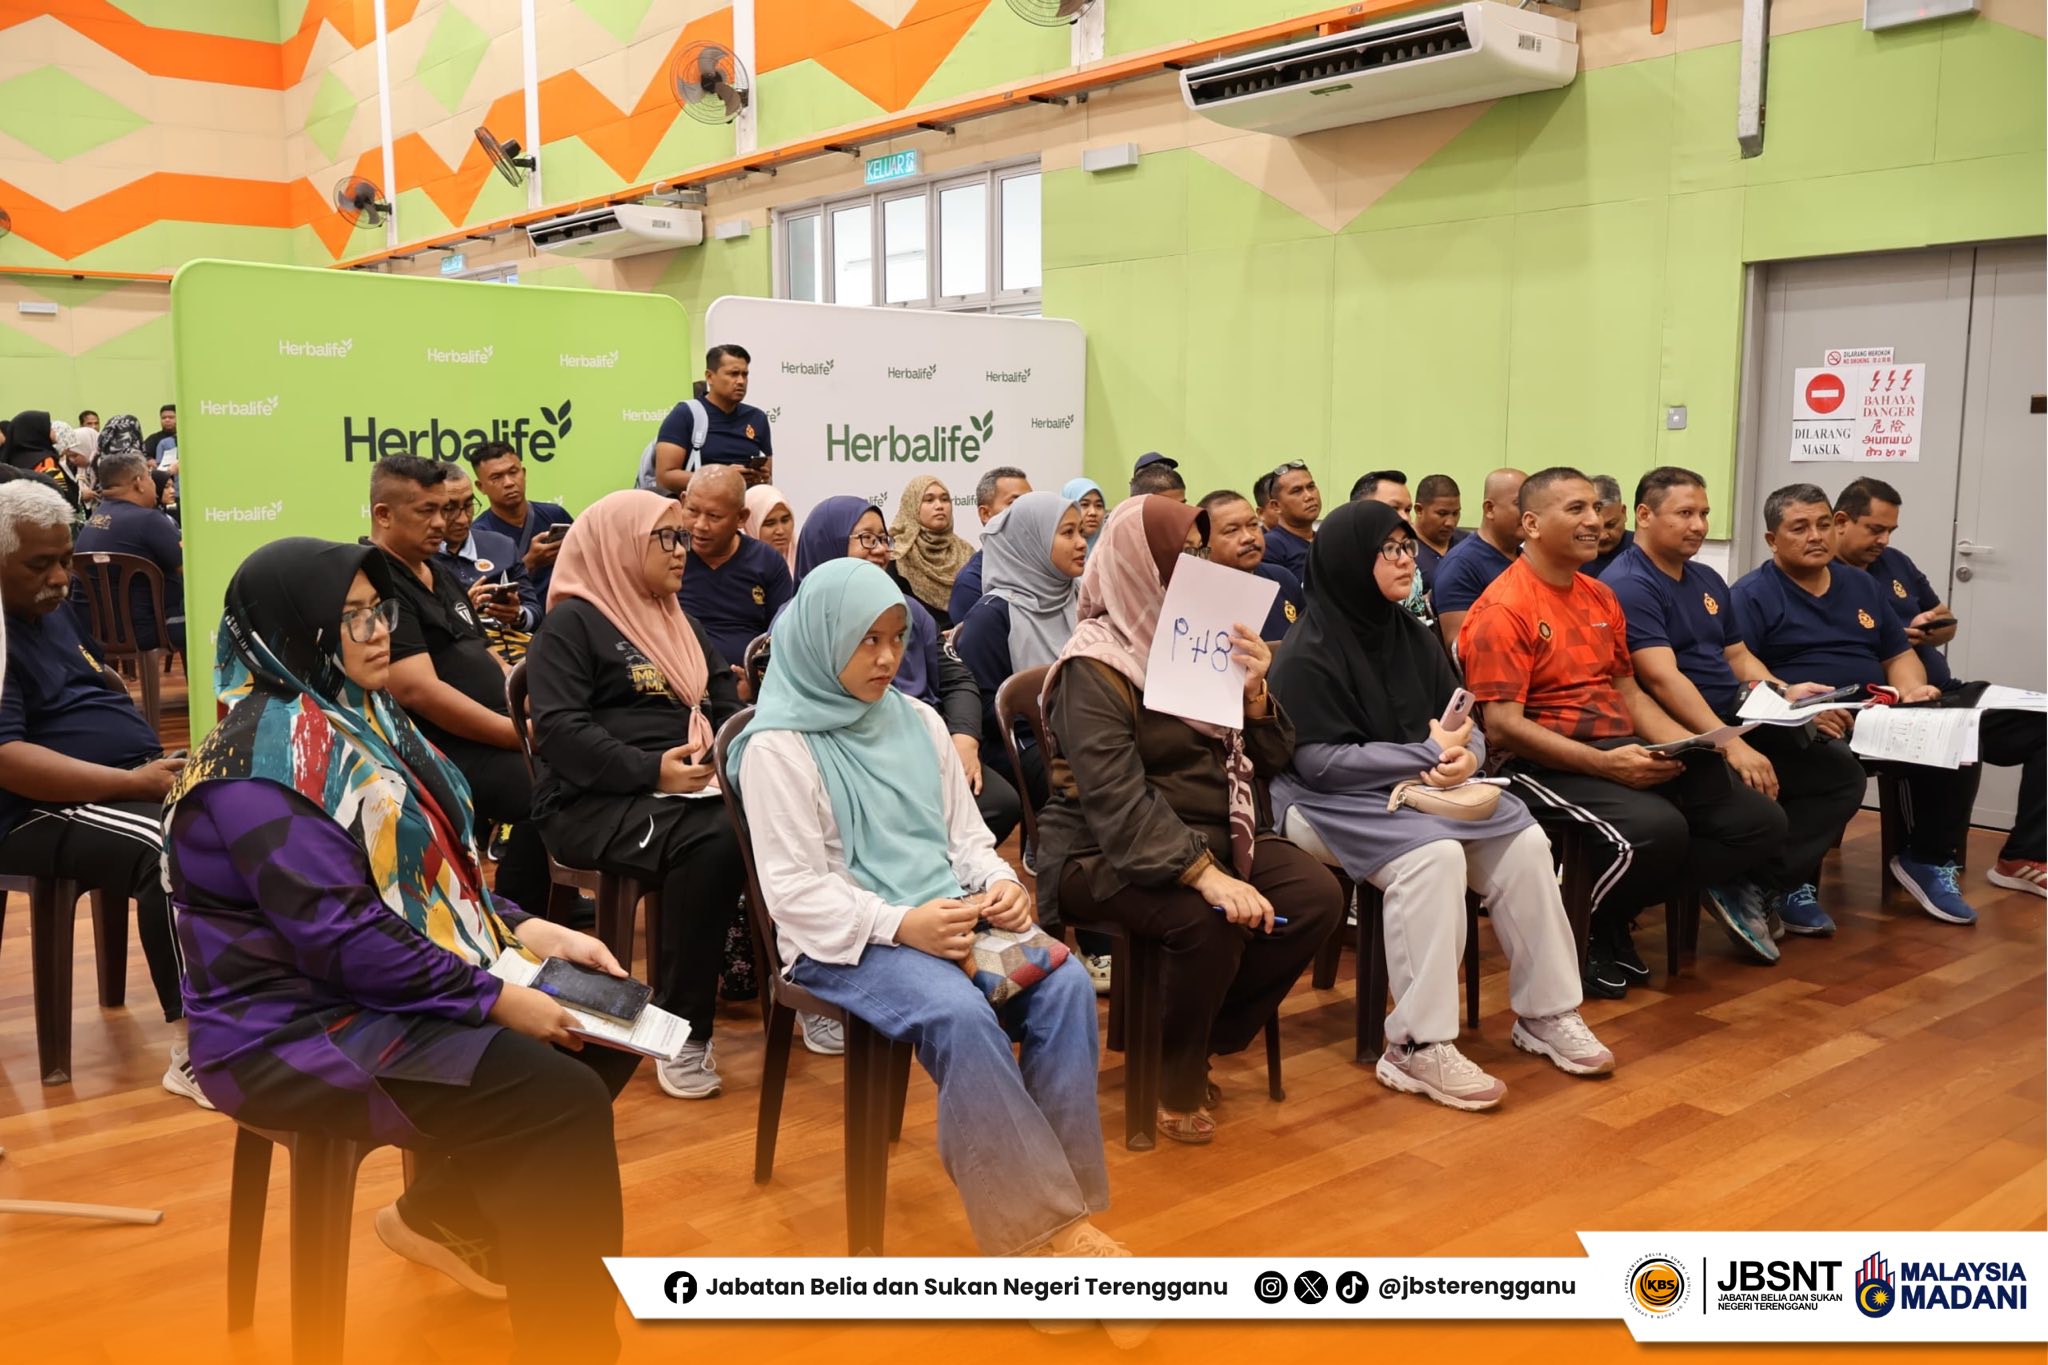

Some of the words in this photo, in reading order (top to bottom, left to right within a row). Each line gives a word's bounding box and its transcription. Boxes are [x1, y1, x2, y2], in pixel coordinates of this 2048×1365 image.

[867, 153, 904, 181] KELUAR
[278, 340, 347, 357] Herbalife
[427, 348, 487, 364] Herbalife
[559, 353, 613, 368] Herbalife
[781, 362, 830, 376] Herbalife
[887, 367, 932, 380] Herbalife
[985, 371, 1027, 383] Herbalife
[1864, 396, 1915, 405] BAHAYA
[200, 400, 272, 417] Herbalife
[622, 408, 669, 422] Herbalif
[1864, 407, 1915, 417] DANGER
[1031, 418, 1070, 429] Herbalife
[344, 416, 556, 463] Herbalife
[1795, 428, 1851, 439] DILARANG
[827, 423, 981, 463] Herbalife
[1801, 444, 1841, 455] MASUK
[205, 507, 277, 522] Herbalife
